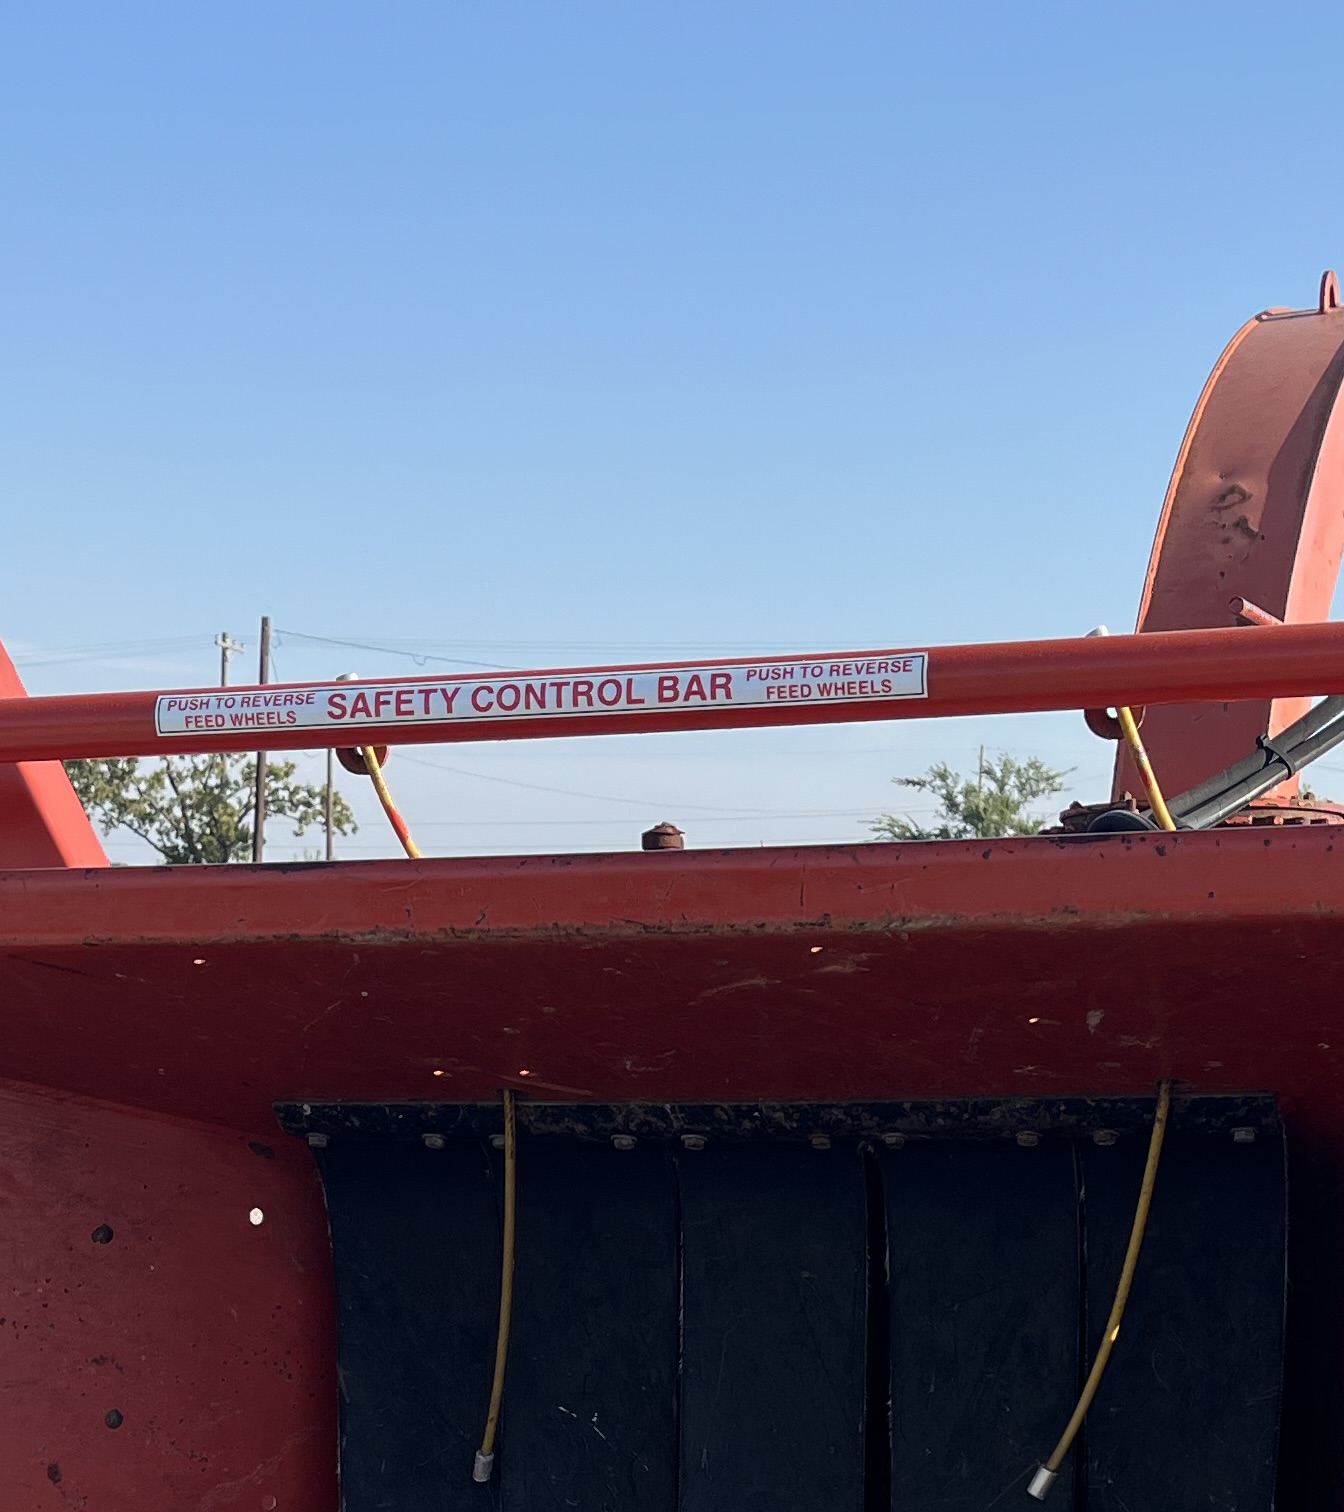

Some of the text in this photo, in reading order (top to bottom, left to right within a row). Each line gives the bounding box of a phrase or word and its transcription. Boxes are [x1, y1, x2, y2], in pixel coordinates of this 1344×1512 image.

[746, 660, 913, 682] PUSH TO REVERSE
[326, 673, 733, 720] SAFETY CONTROL BAR
[766, 679, 892, 700] FEED WHEELS
[167, 693, 315, 712] PUSH TO REVERSE
[185, 710, 297, 729] FEED WHEELS
